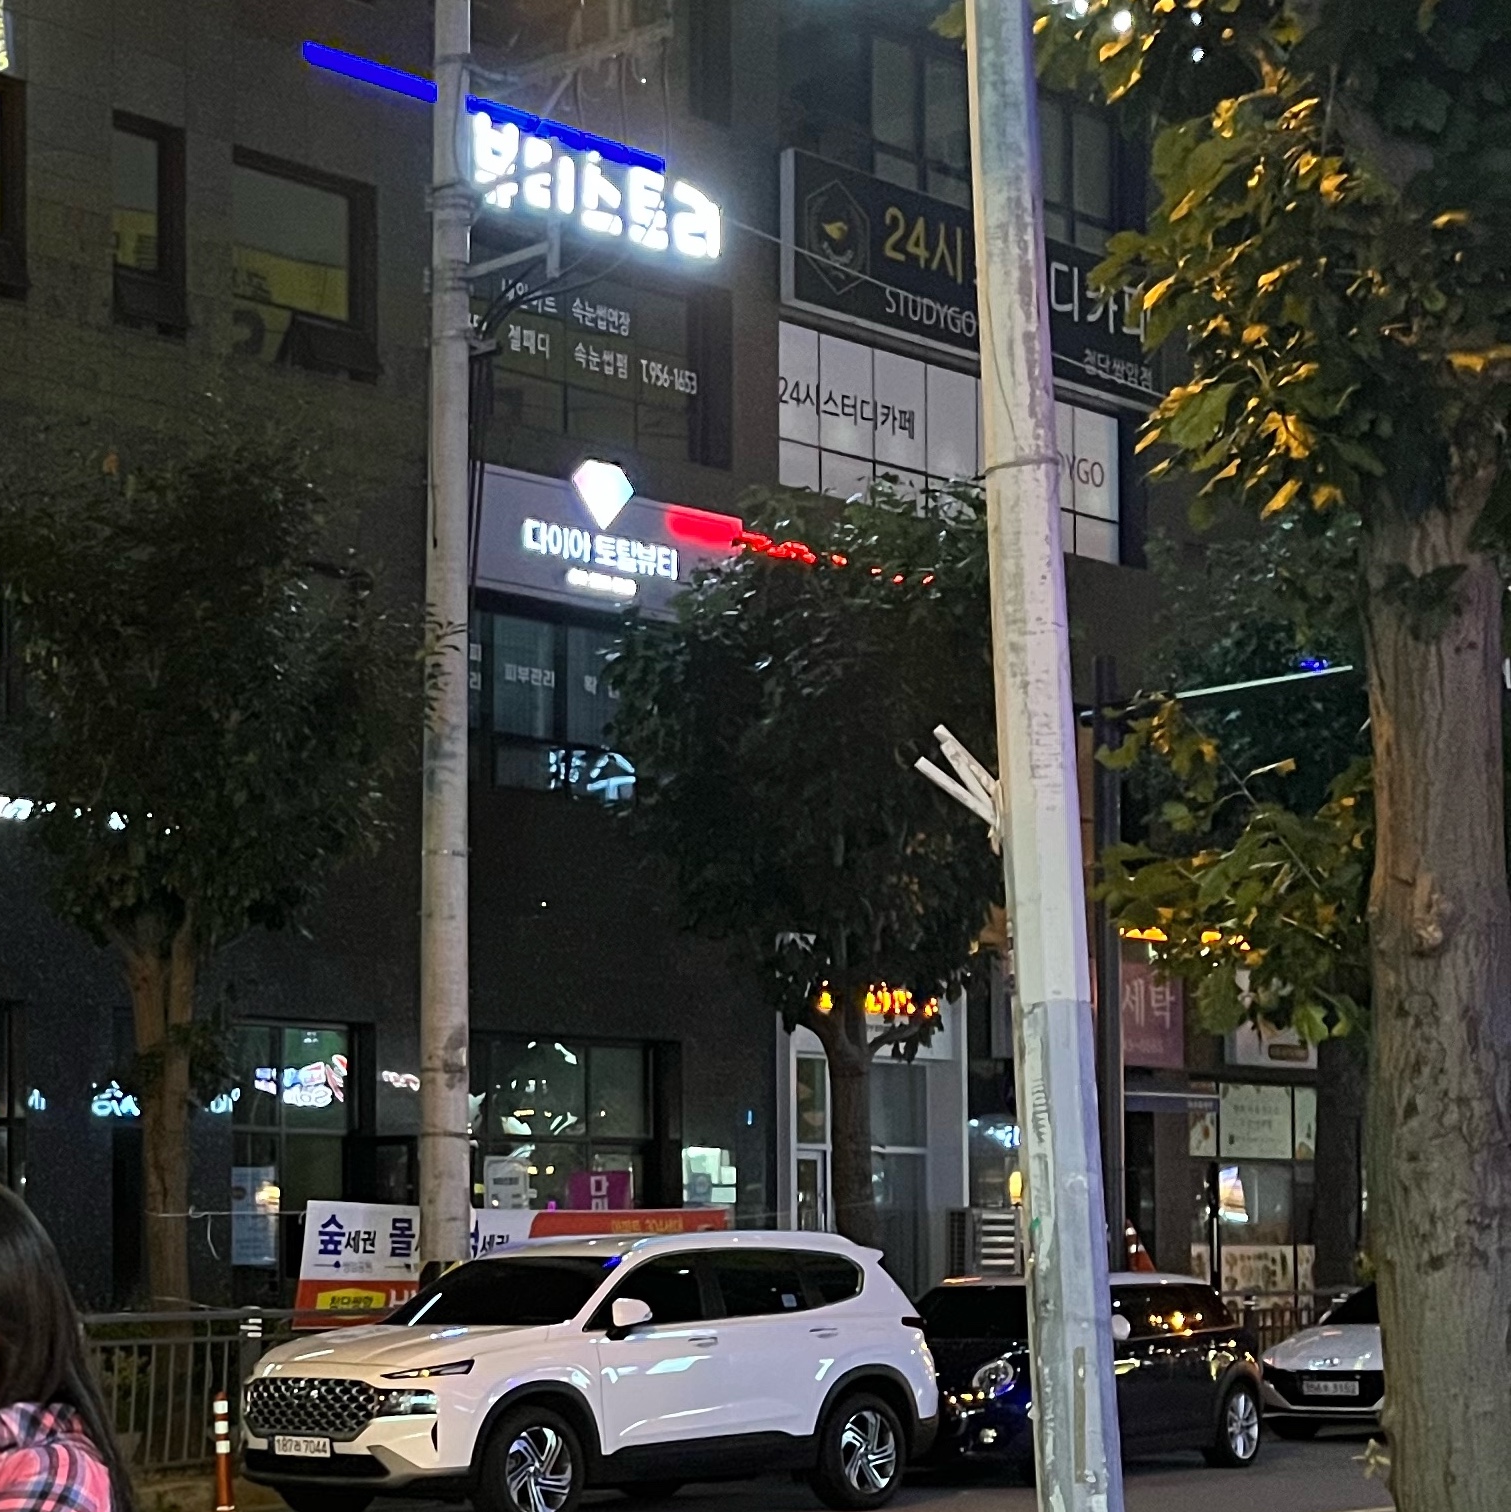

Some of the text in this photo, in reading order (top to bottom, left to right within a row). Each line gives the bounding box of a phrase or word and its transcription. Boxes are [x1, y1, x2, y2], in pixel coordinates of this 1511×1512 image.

[884, 206, 963, 285] 24시
[572, 297, 631, 337] 속눈썹연장
[885, 287, 977, 338] STUDYGO
[508, 324, 551, 360] 젤패디
[574, 342, 629, 380] 속눈썹펌
[523, 518, 592, 563] 다이아
[504, 663, 555, 688] 피부관리
[318, 1214, 377, 1256] 숲세권
[302, 1439, 328, 1454] 7044
